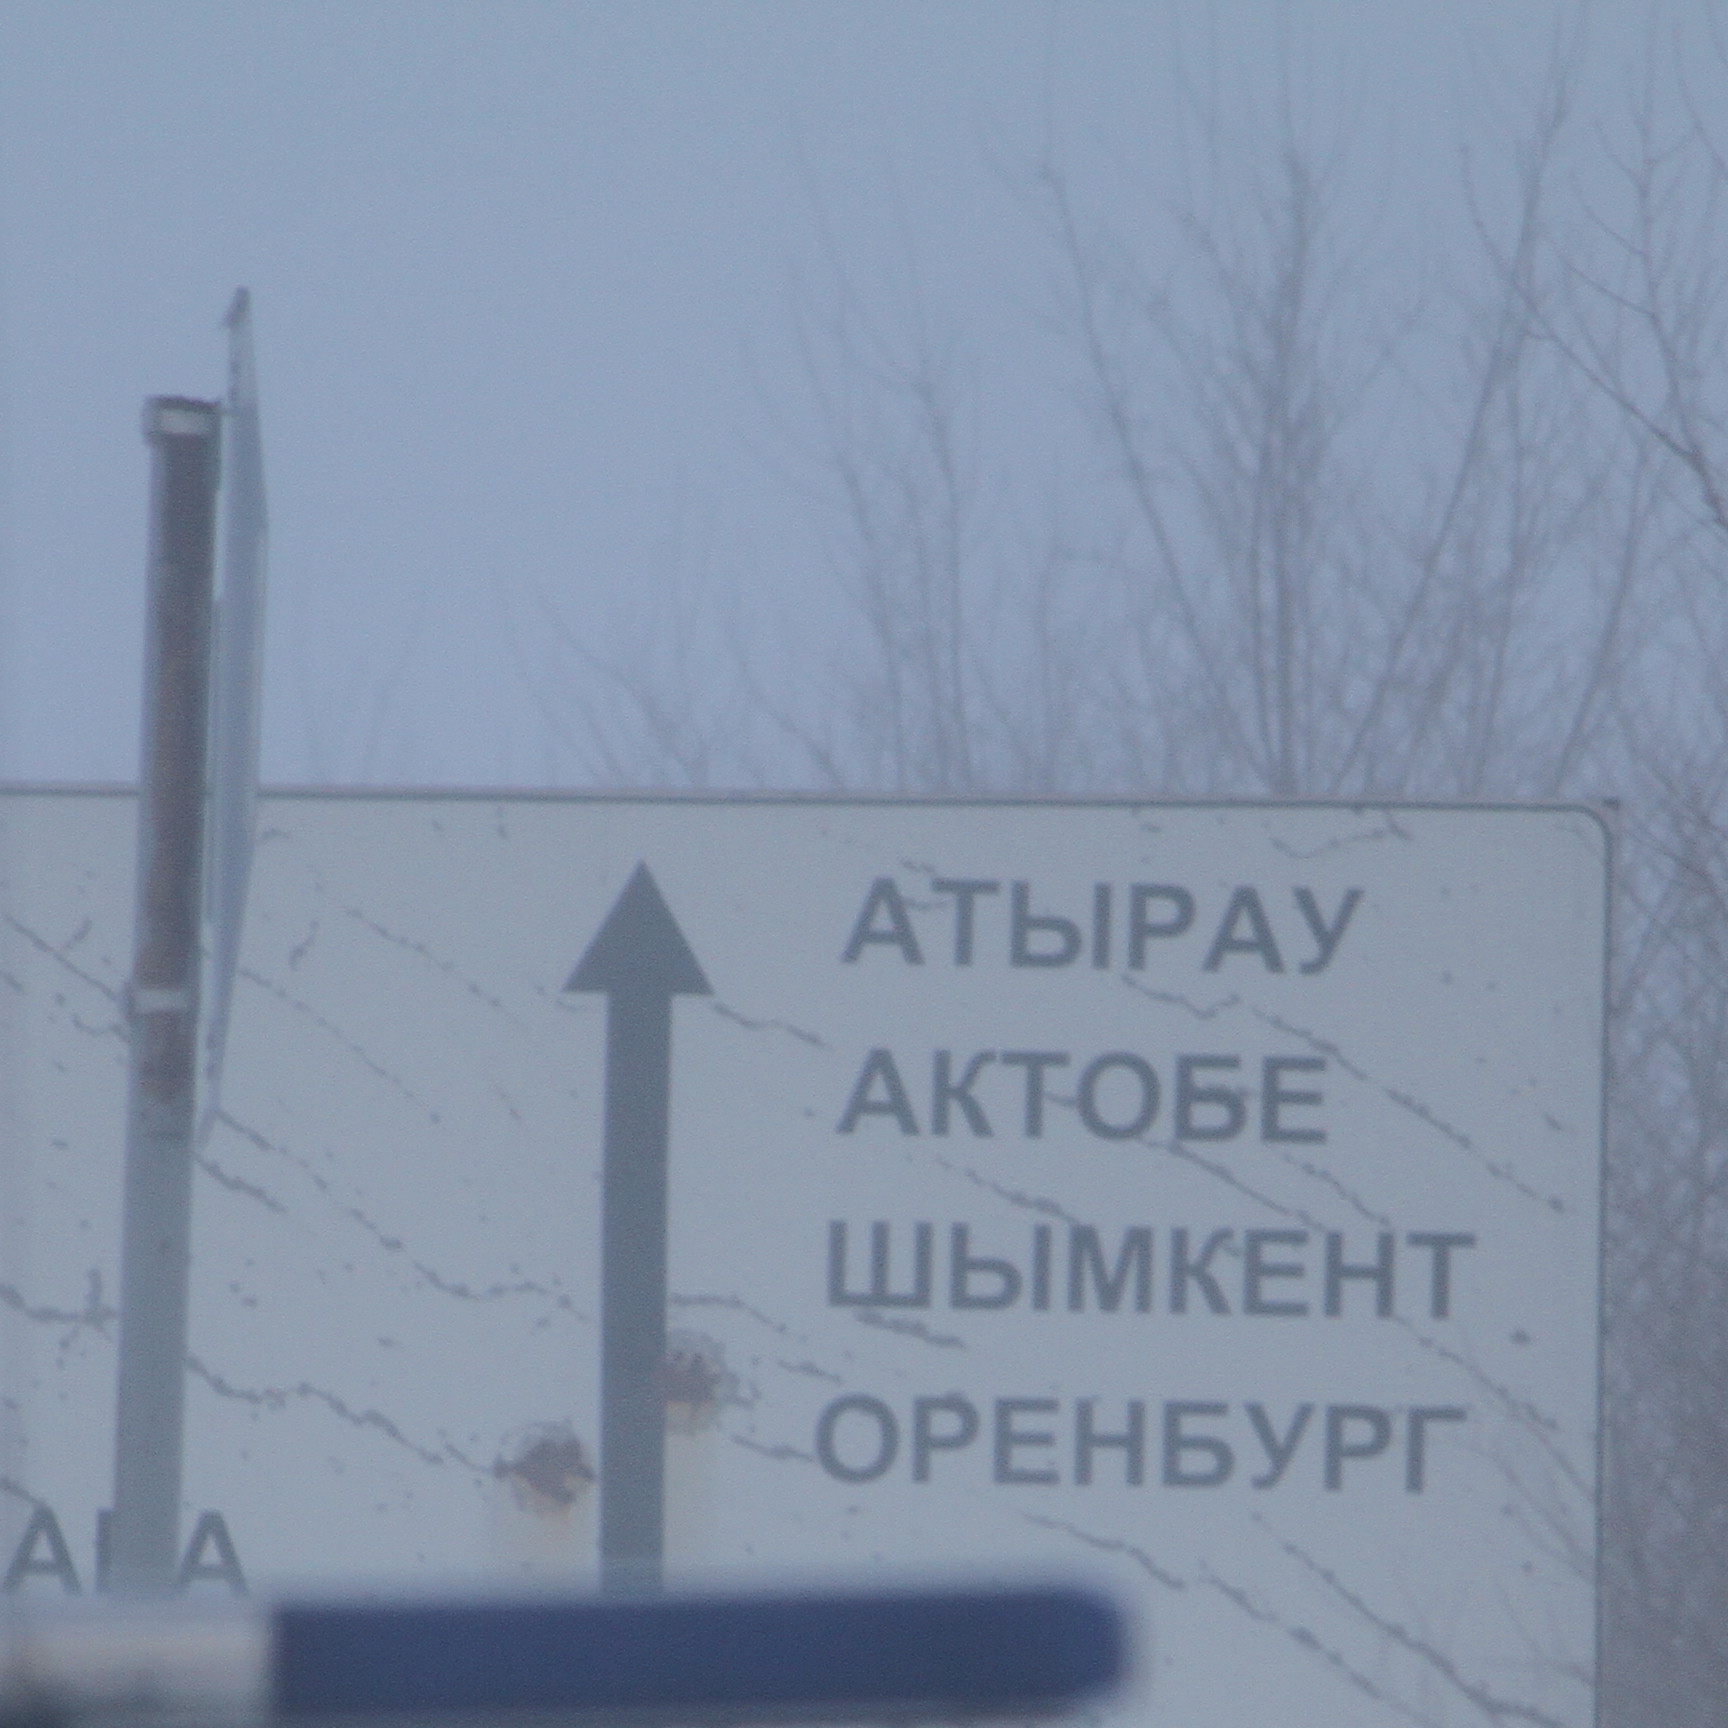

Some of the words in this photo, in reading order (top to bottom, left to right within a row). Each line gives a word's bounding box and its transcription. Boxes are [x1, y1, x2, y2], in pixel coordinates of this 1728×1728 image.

[840, 875, 1365, 975] АТЫРАУ
[835, 1047, 1329, 1144] АКТОБЕ
[826, 1219, 1478, 1319] ШЫМКЕНТ
[814, 1393, 1468, 1494] ОРЕНБУРГ
